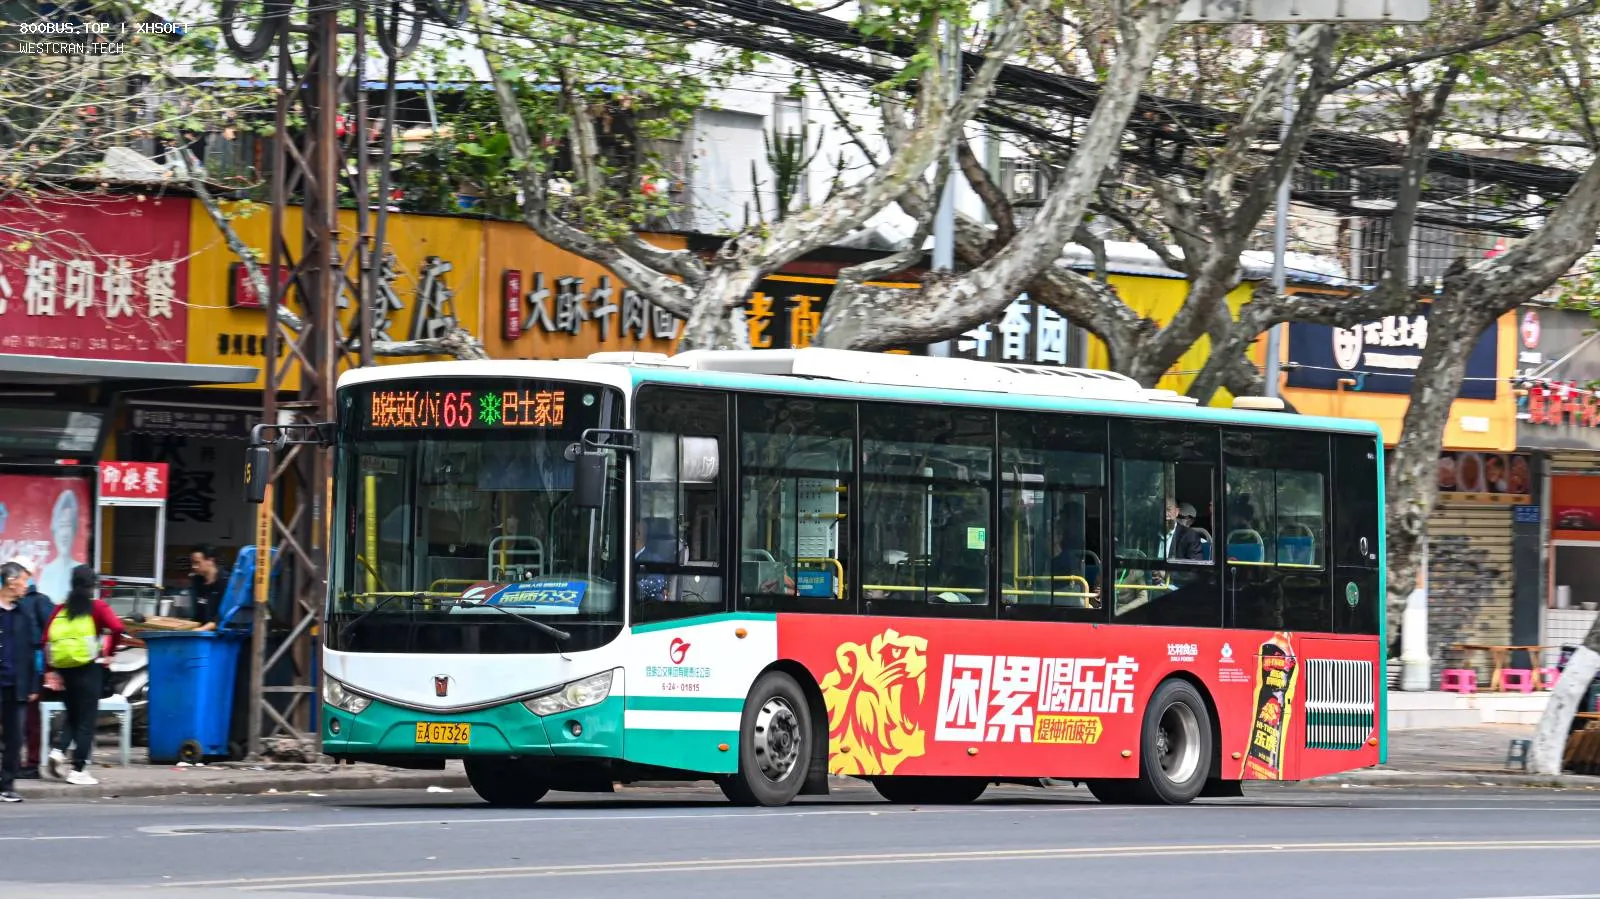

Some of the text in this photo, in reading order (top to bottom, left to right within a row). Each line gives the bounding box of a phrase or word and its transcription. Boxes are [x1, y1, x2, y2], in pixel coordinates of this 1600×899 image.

[443, 391, 473, 428] 65
[934, 653, 1139, 743] 困累喝乐虎
[1037, 718, 1098, 742] 提神抗疲劳
